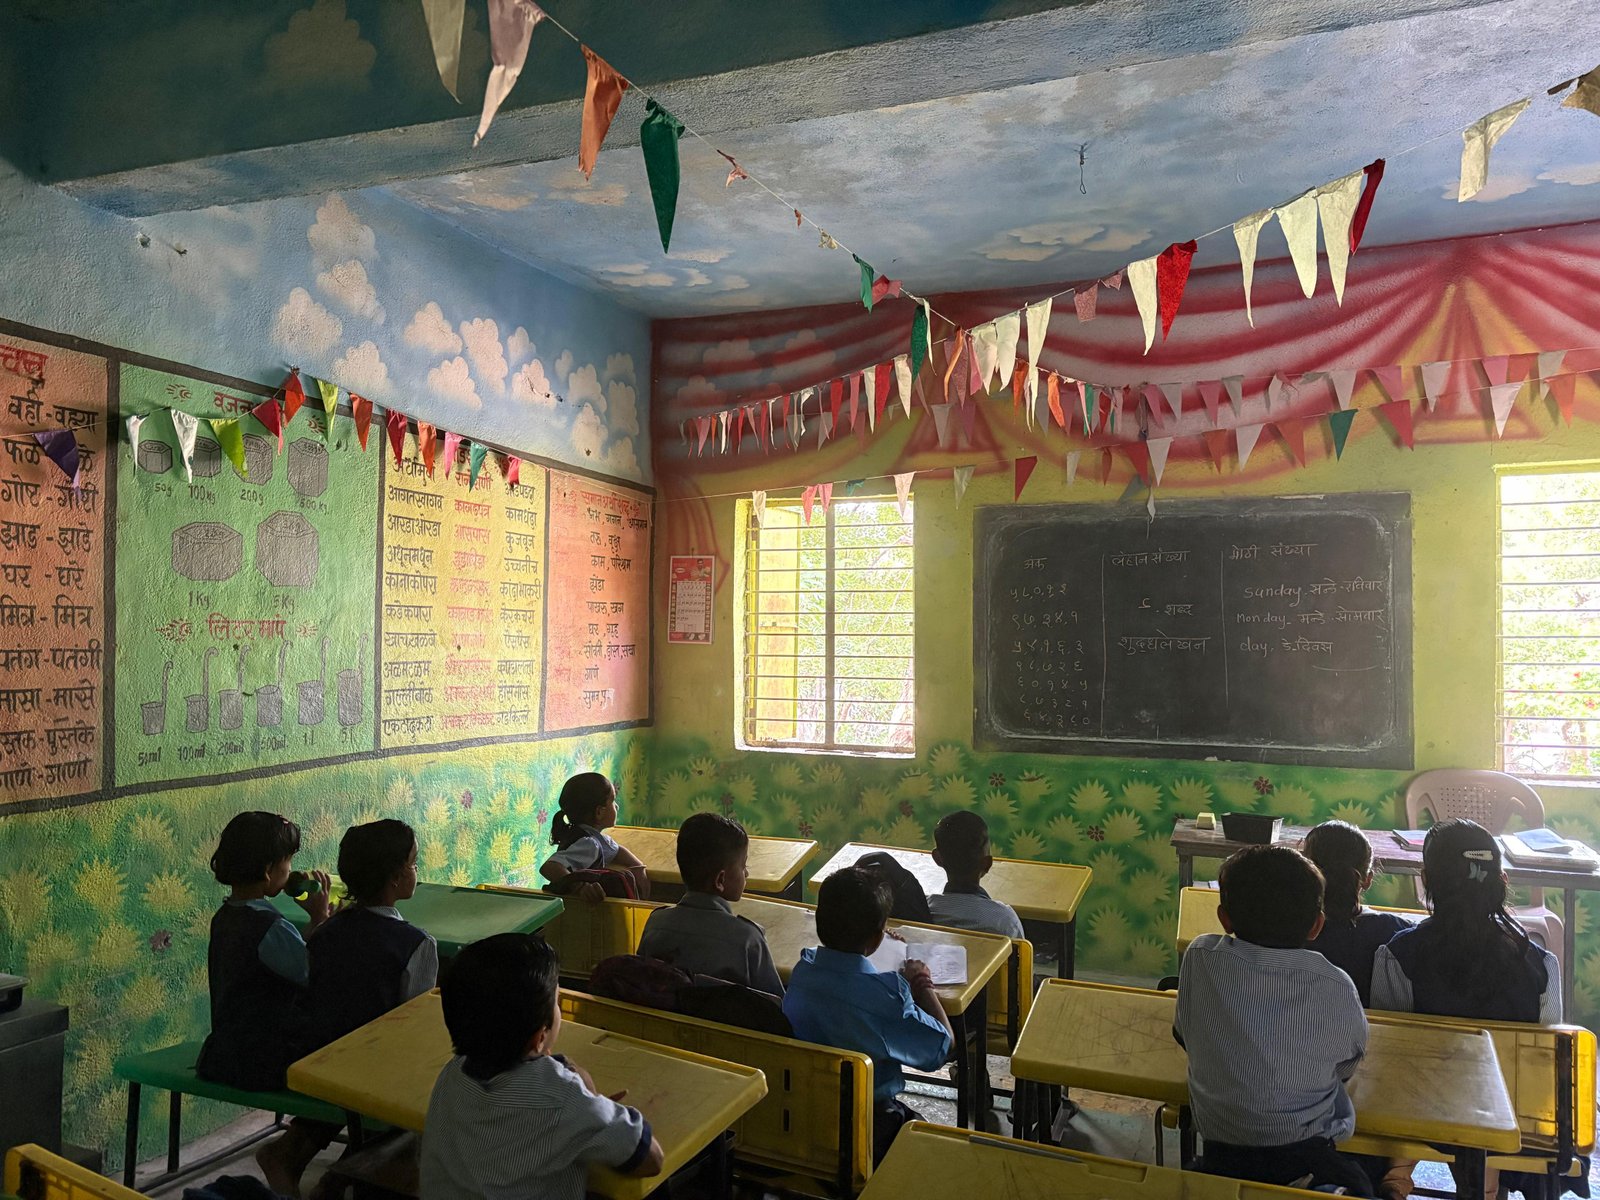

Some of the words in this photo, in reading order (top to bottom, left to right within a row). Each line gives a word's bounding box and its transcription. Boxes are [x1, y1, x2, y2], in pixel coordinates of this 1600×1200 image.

[1, 564, 32, 588] घर
[55, 560, 84, 590] घरे
[52, 594, 93, 630] मित्र
